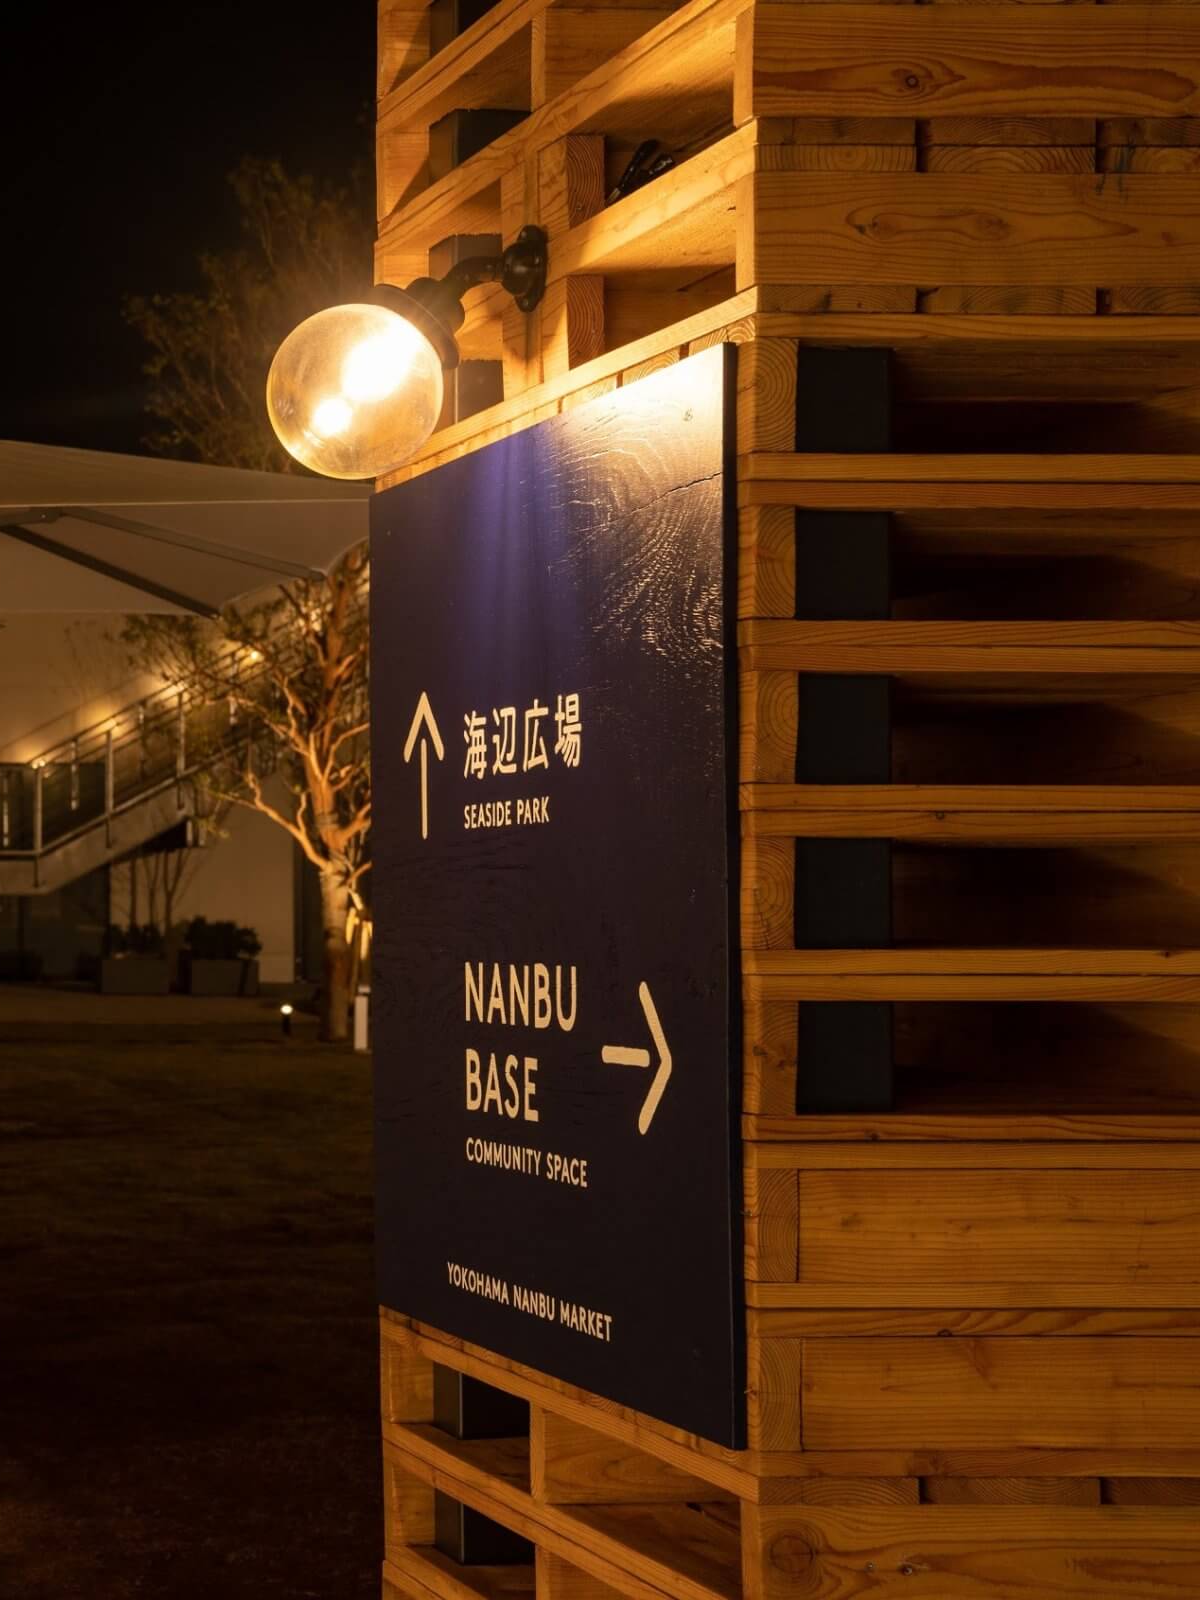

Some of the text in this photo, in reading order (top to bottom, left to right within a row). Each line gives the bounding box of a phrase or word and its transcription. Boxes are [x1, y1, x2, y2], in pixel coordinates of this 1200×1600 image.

[463, 692, 583, 780] 海辺広場
[463, 795, 550, 830] SEASIDE PARK
[464, 961, 577, 1032] NANBU
[465, 1048, 539, 1123] BASE
[465, 1137, 588, 1188] COMMUNITY SPACE
[447, 1261, 613, 1342] YOKOHAMA NANBU MARKET
